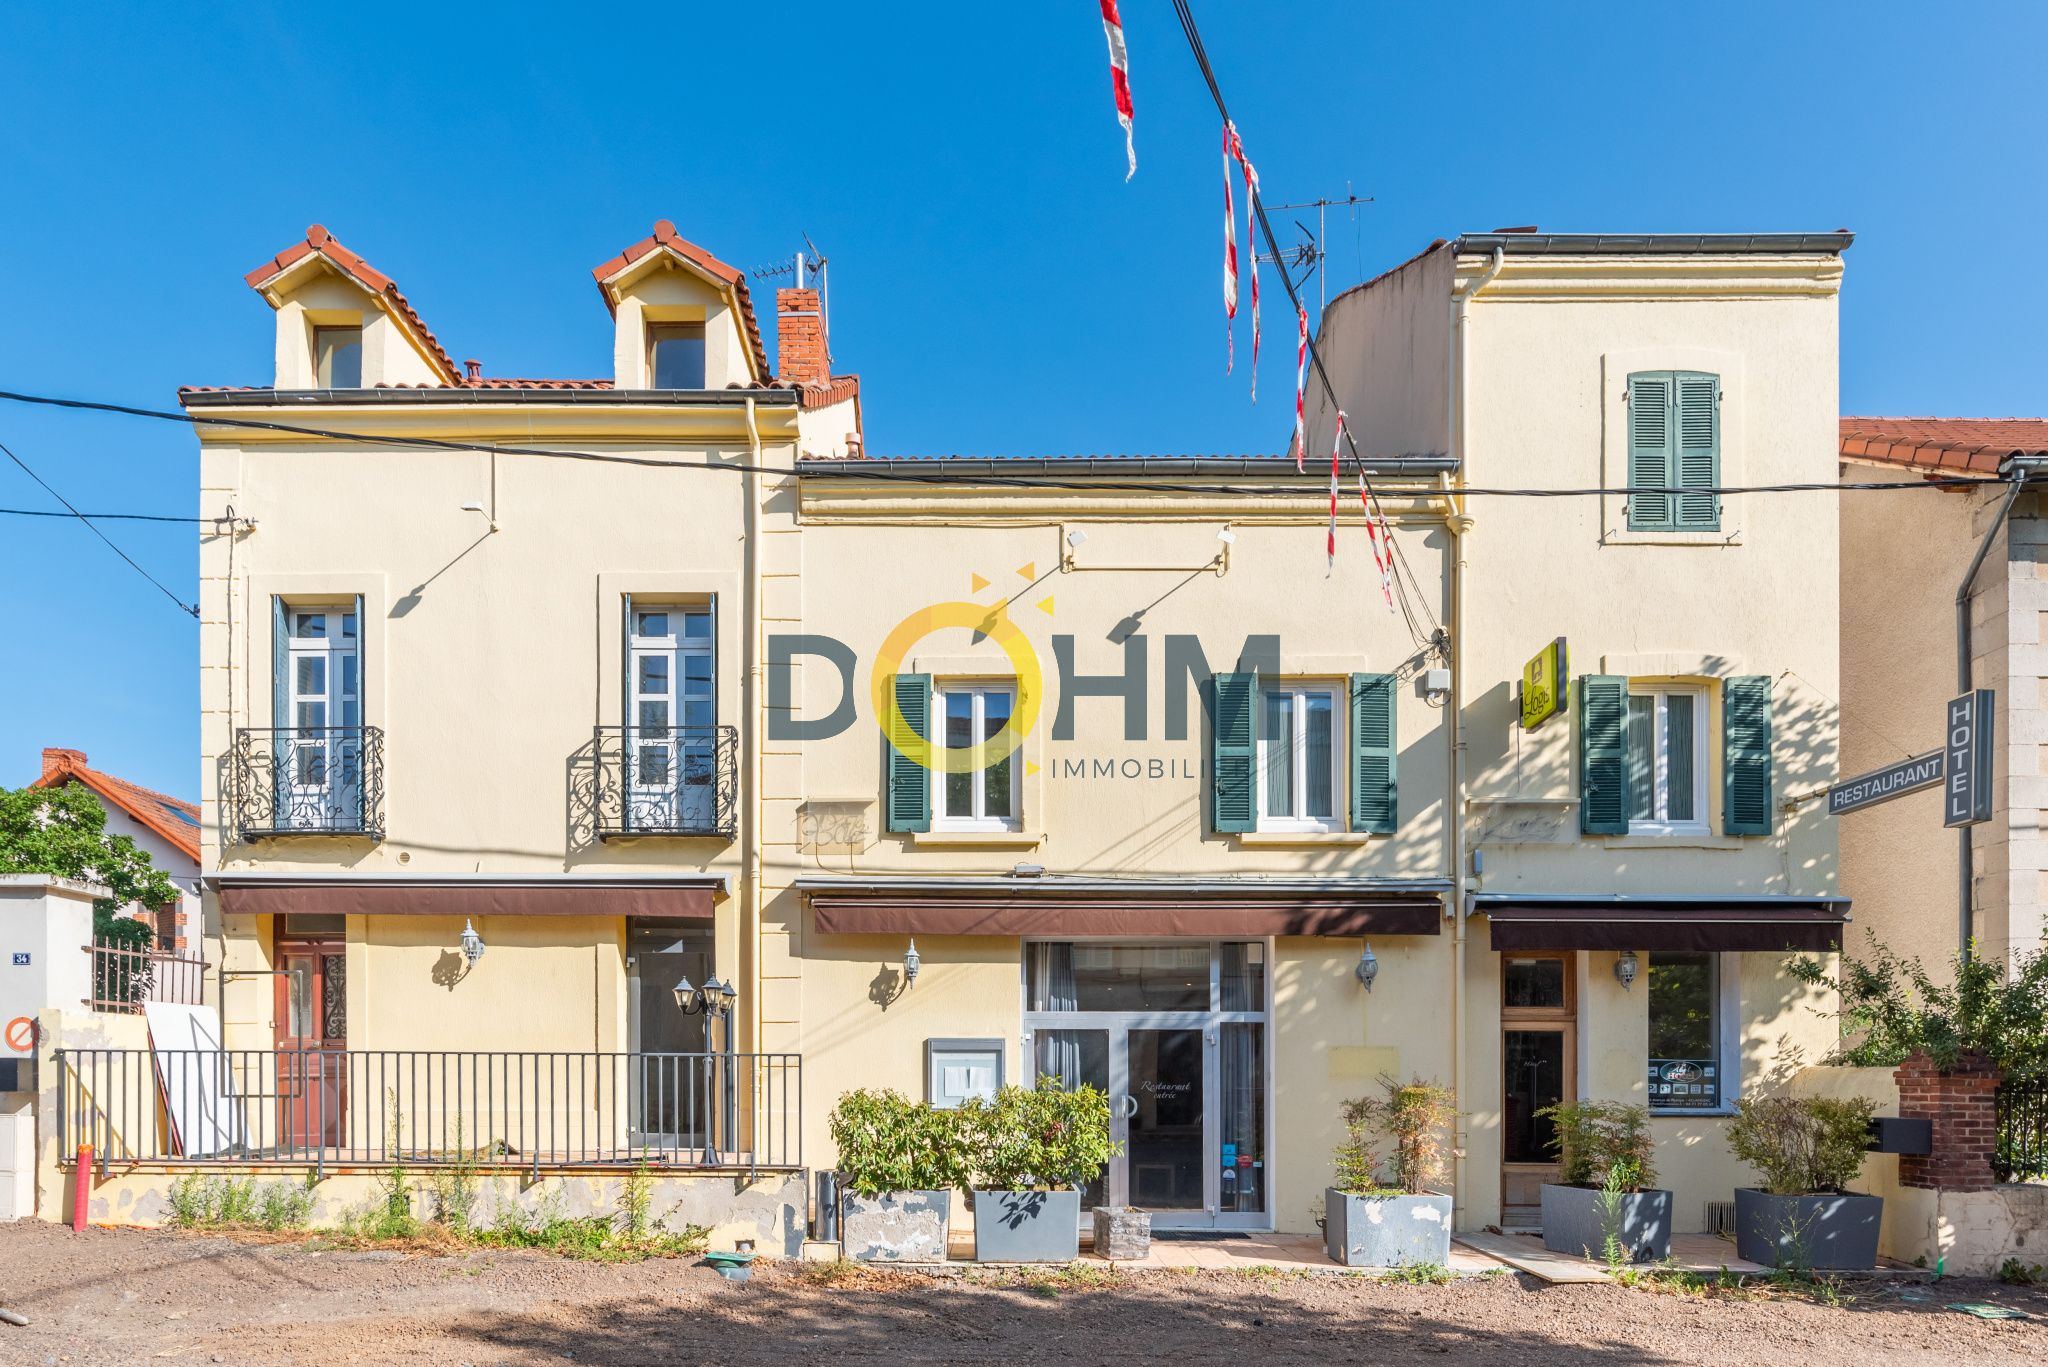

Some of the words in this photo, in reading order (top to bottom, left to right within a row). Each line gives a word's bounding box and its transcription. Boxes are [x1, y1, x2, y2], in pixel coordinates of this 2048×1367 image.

[1523, 685, 1551, 720] Logis
[1951, 701, 1971, 817] HOTEL
[1834, 758, 1940, 808] RESTAURANT
[16, 954, 27, 963] 34
[1140, 1080, 1191, 1093] Restaurant
[1153, 1090, 1177, 1099] entrée
